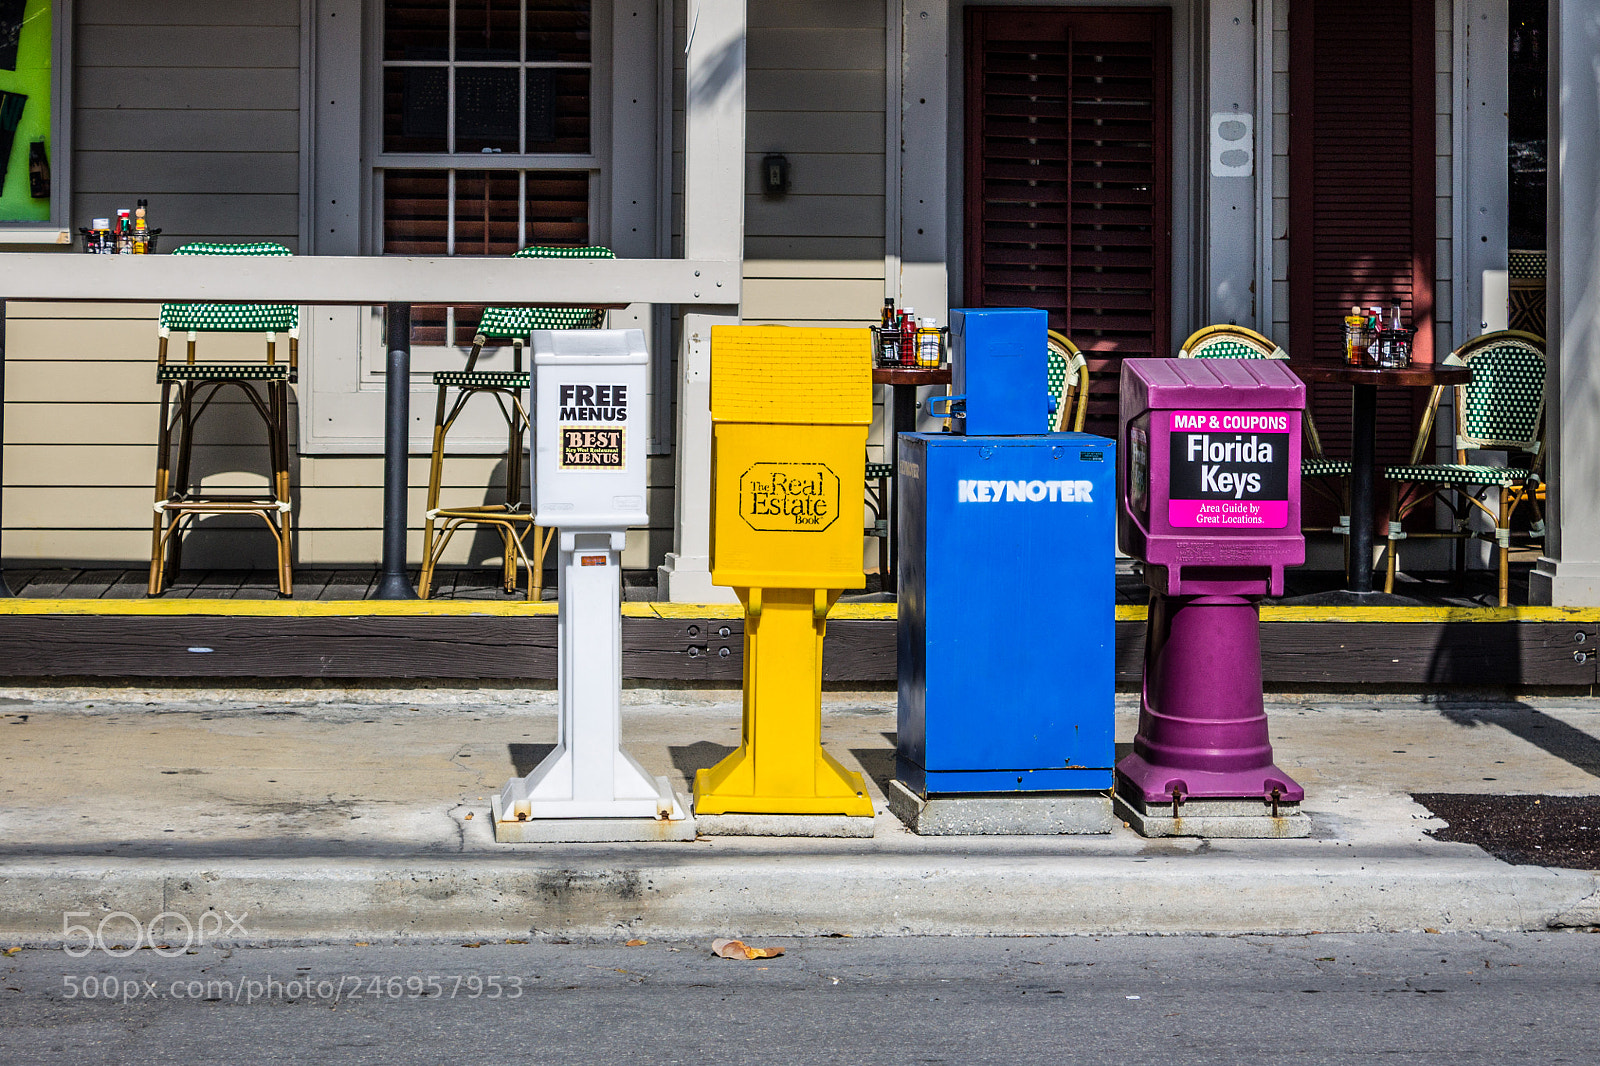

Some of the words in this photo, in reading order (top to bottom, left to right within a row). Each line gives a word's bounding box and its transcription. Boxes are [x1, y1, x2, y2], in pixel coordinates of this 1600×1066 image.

[559, 385, 627, 407] FREE
[559, 407, 628, 422] MENUS
[1174, 415, 1206, 428] MAP
[1208, 416, 1220, 429] &
[1223, 416, 1287, 430] COUPONS
[565, 431, 620, 448] BEST
[1187, 434, 1273, 463] Florida
[565, 452, 620, 464] MENUS
[750, 481, 770, 492] The
[770, 472, 825, 496] Real
[958, 480, 1094, 503] KEYNOTER
[1201, 465, 1261, 500] Keys
[750, 492, 827, 516] Estate
[1199, 504, 1220, 513] Area
[1221, 503, 1248, 513] Guide
[1249, 503, 1260, 515] by
[1196, 514, 1220, 524] Great
[1222, 514, 1265, 524] Locations.
